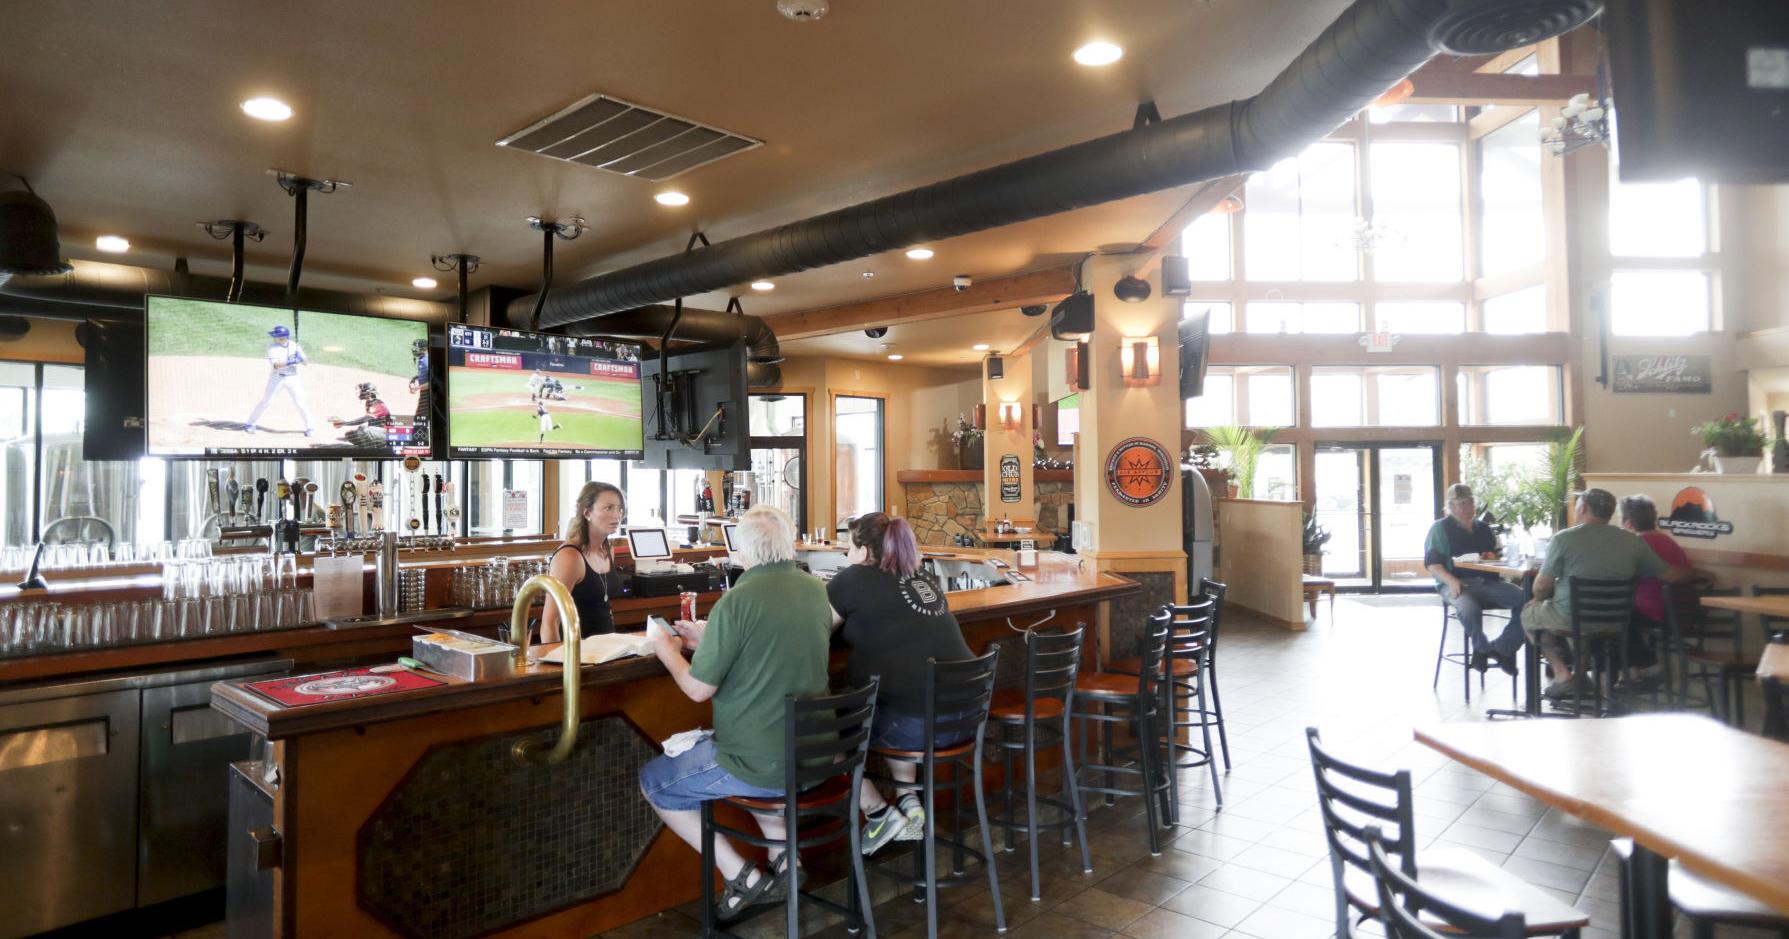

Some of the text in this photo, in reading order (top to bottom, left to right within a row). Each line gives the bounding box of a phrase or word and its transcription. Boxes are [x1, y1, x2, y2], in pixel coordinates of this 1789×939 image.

[469, 353, 518, 365] CRAFTSMAN
[593, 365, 634, 374] CRAFTSMAN
[1659, 520, 1730, 532] BLACKROCKS
